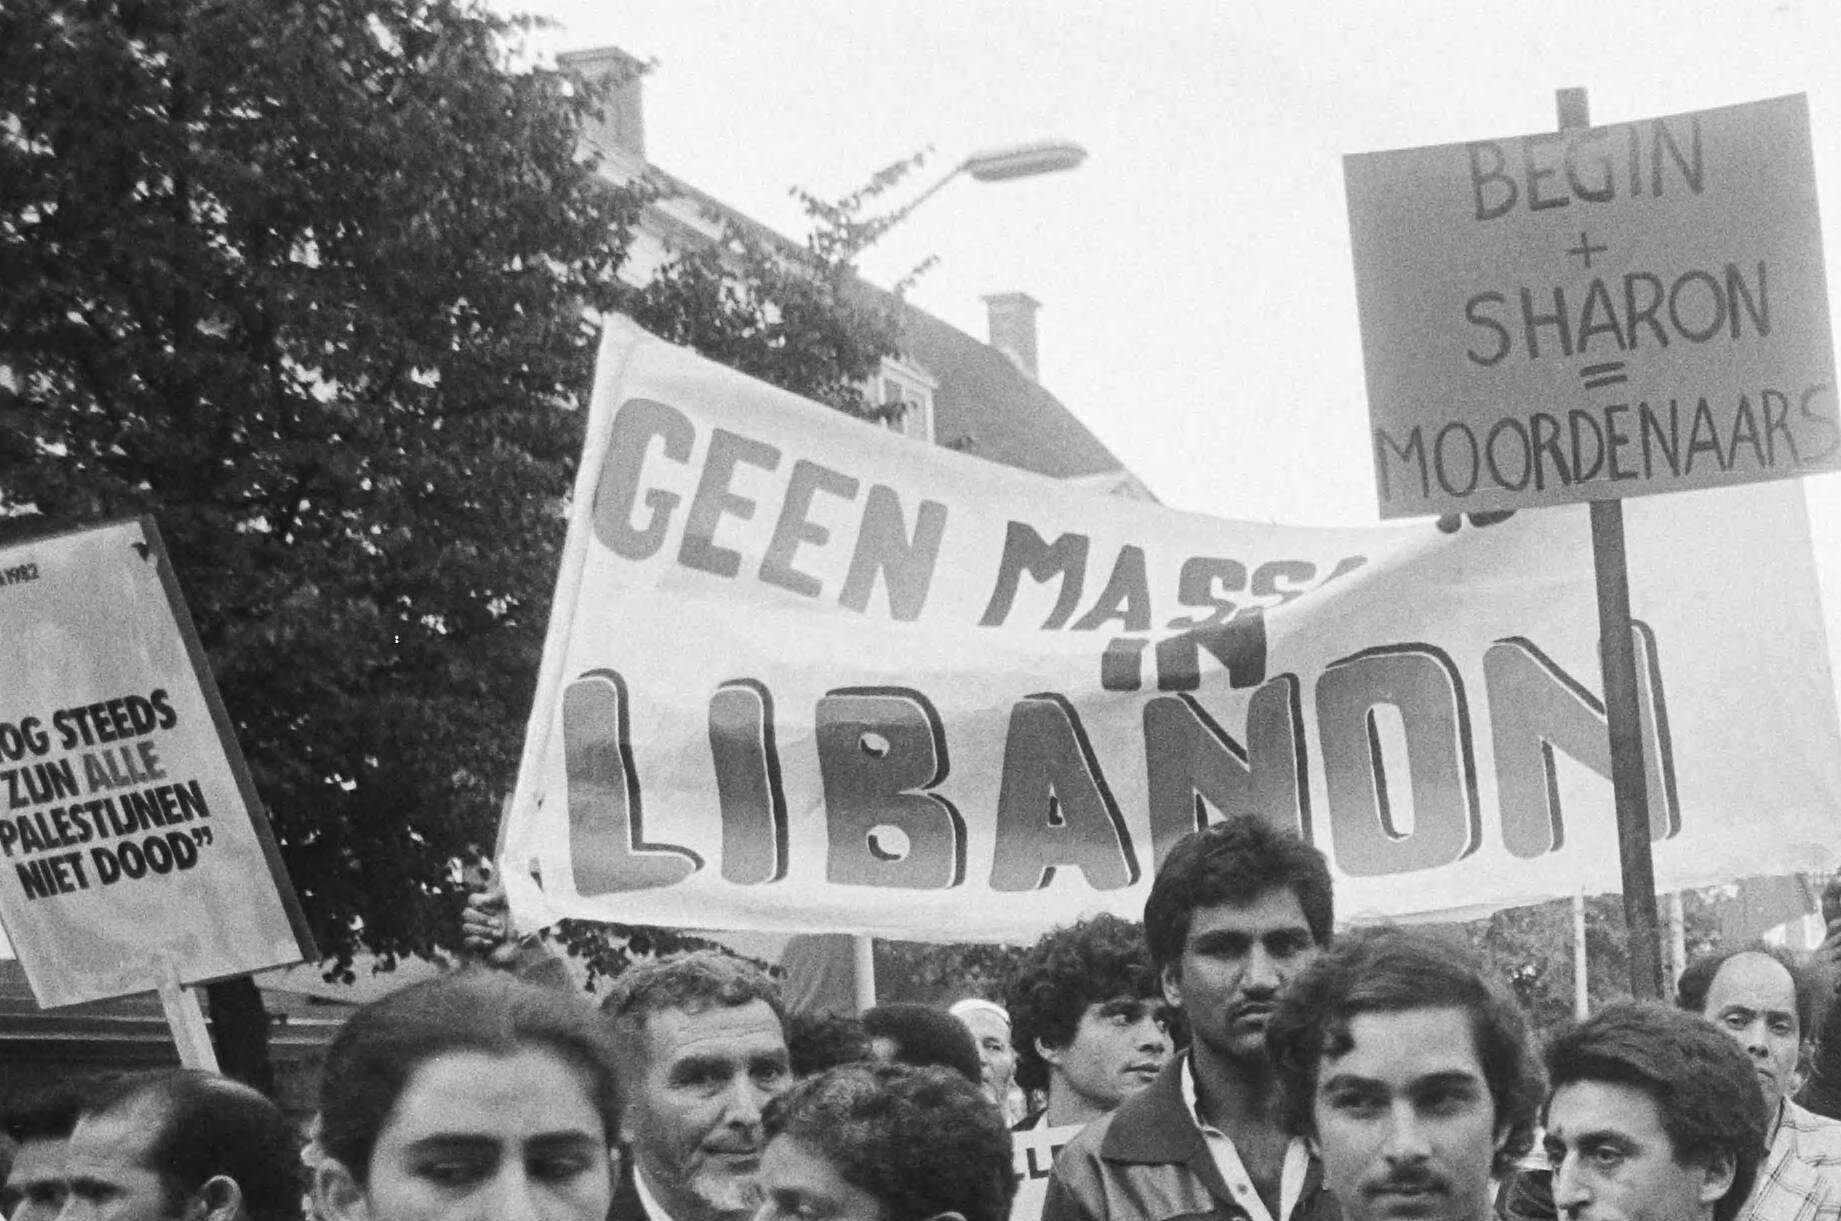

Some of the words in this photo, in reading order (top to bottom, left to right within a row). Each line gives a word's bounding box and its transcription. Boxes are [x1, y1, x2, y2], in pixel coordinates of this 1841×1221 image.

[1467, 117, 1706, 221] BEGIN
[1464, 260, 1771, 367] SHARON
[1372, 383, 1840, 500] MOORDENAARS
[594, 397, 949, 622] GEEN
[0, 716, 51, 764] OG
[52, 688, 178, 751] STEEDS
[0, 758, 80, 810] ZIJN
[83, 740, 167, 794] ALLE
[562, 618, 1682, 898] LIBANON
[0, 779, 211, 858] PALESTIJNEN
[15, 851, 90, 900] NIET
